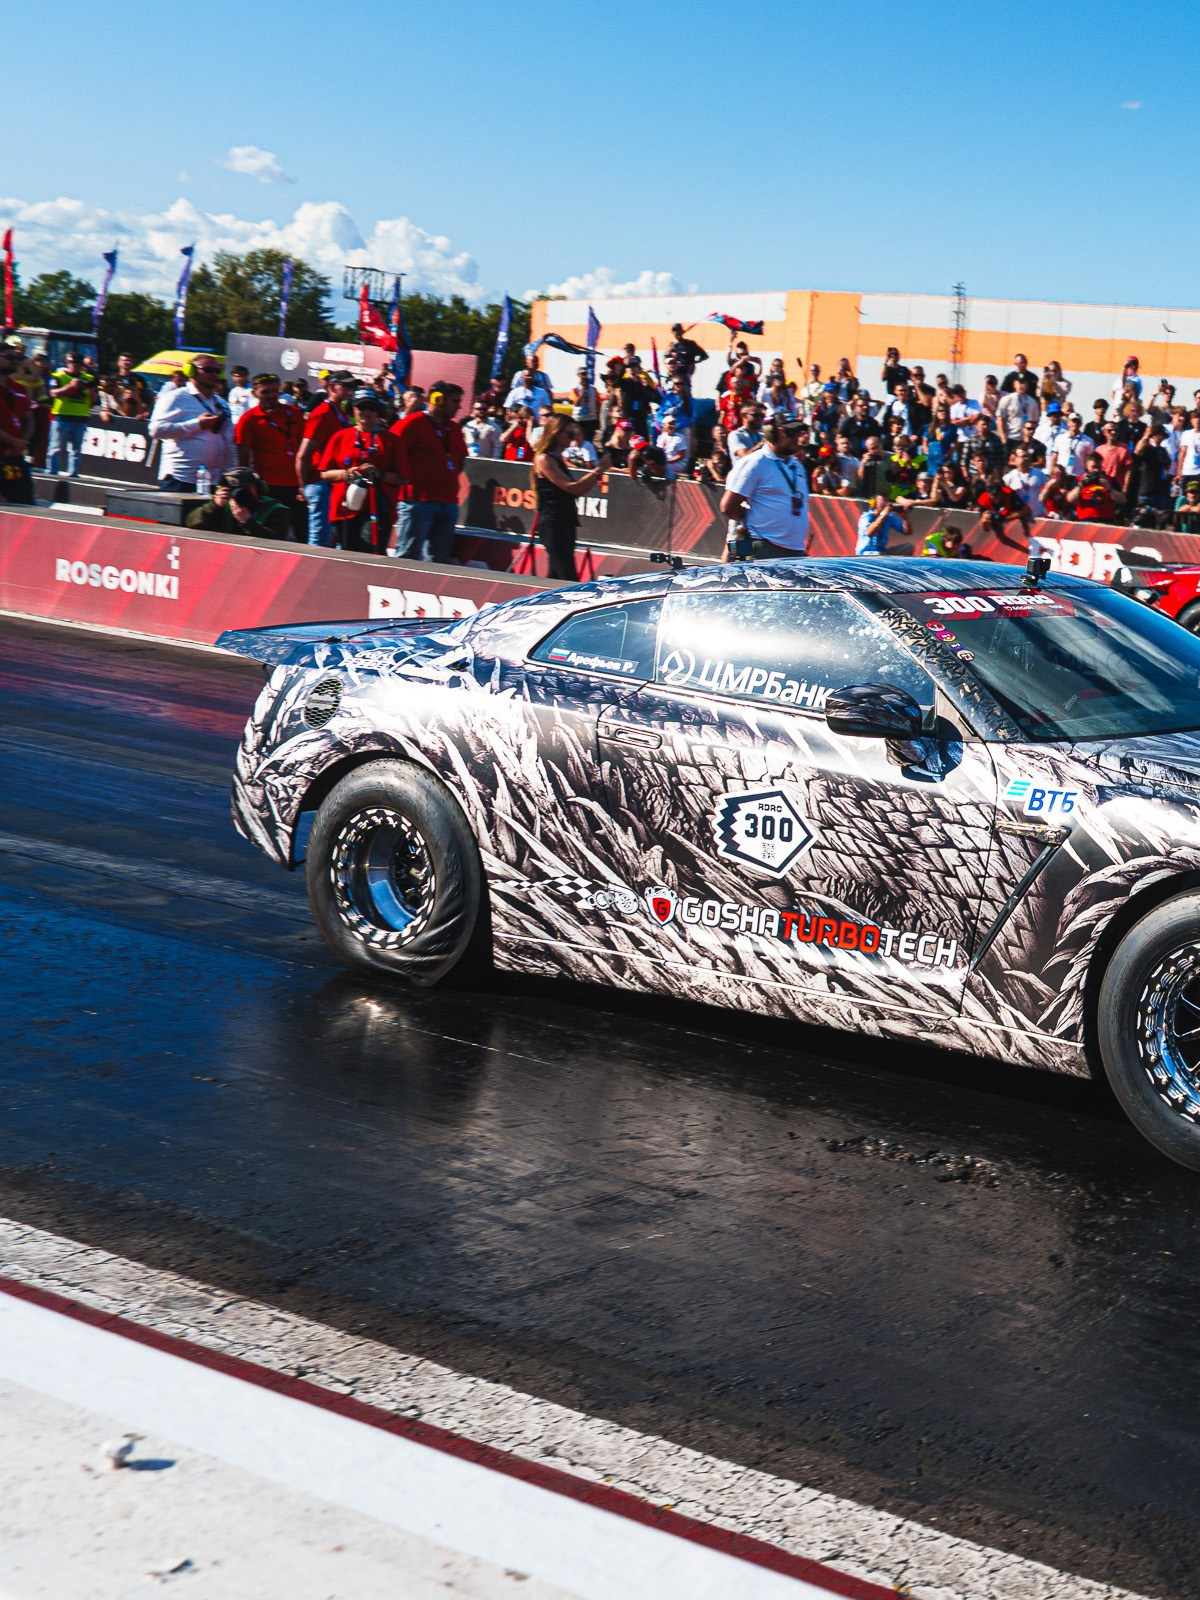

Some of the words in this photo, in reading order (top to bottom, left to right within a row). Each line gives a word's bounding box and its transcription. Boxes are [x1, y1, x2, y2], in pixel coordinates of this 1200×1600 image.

[81, 426, 147, 463] DRC
[55, 558, 180, 600] ROSGONKI
[366, 584, 499, 620] RDR
[923, 596, 996, 615] 300
[699, 659, 837, 709] ЦМРБанк
[1028, 788, 1078, 813] ВТБ
[744, 812, 793, 842] 300
[681, 896, 958, 968] GOSHATURBOTECH
